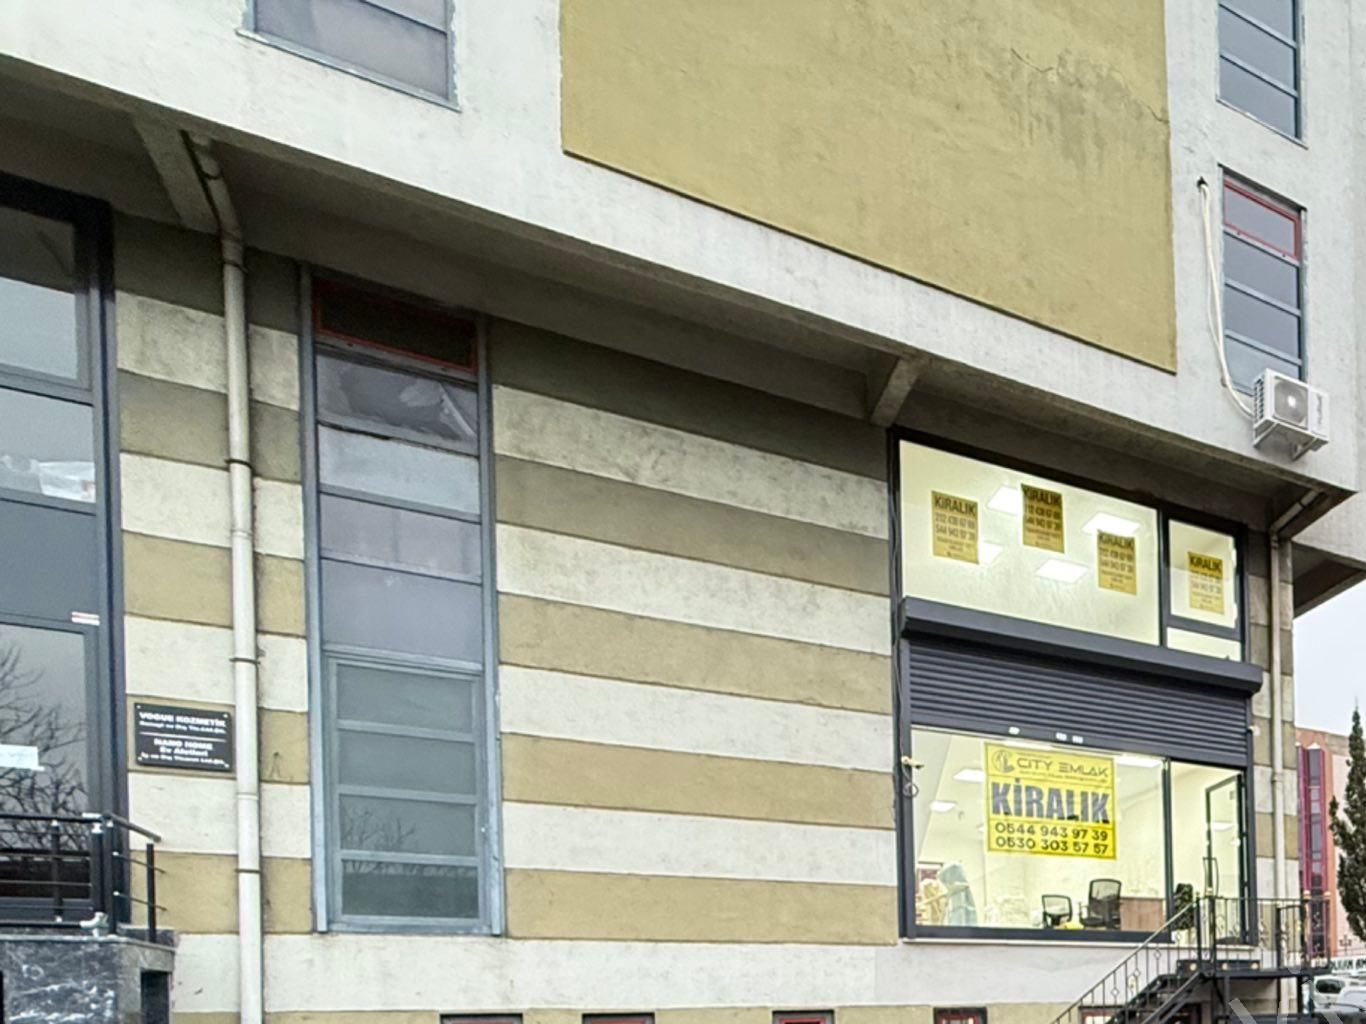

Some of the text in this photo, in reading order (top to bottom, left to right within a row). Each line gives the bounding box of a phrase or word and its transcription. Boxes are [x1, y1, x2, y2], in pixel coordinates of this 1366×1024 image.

[139, 712, 174, 722] VOGUE
[1016, 757, 1053, 771] CITY
[1058, 762, 1109, 777] EMLAK
[991, 777, 1110, 825] KİRALIK
[995, 822, 1108, 841] 0544 943 97 39
[995, 836, 1108, 854] 0530 303 57 57
